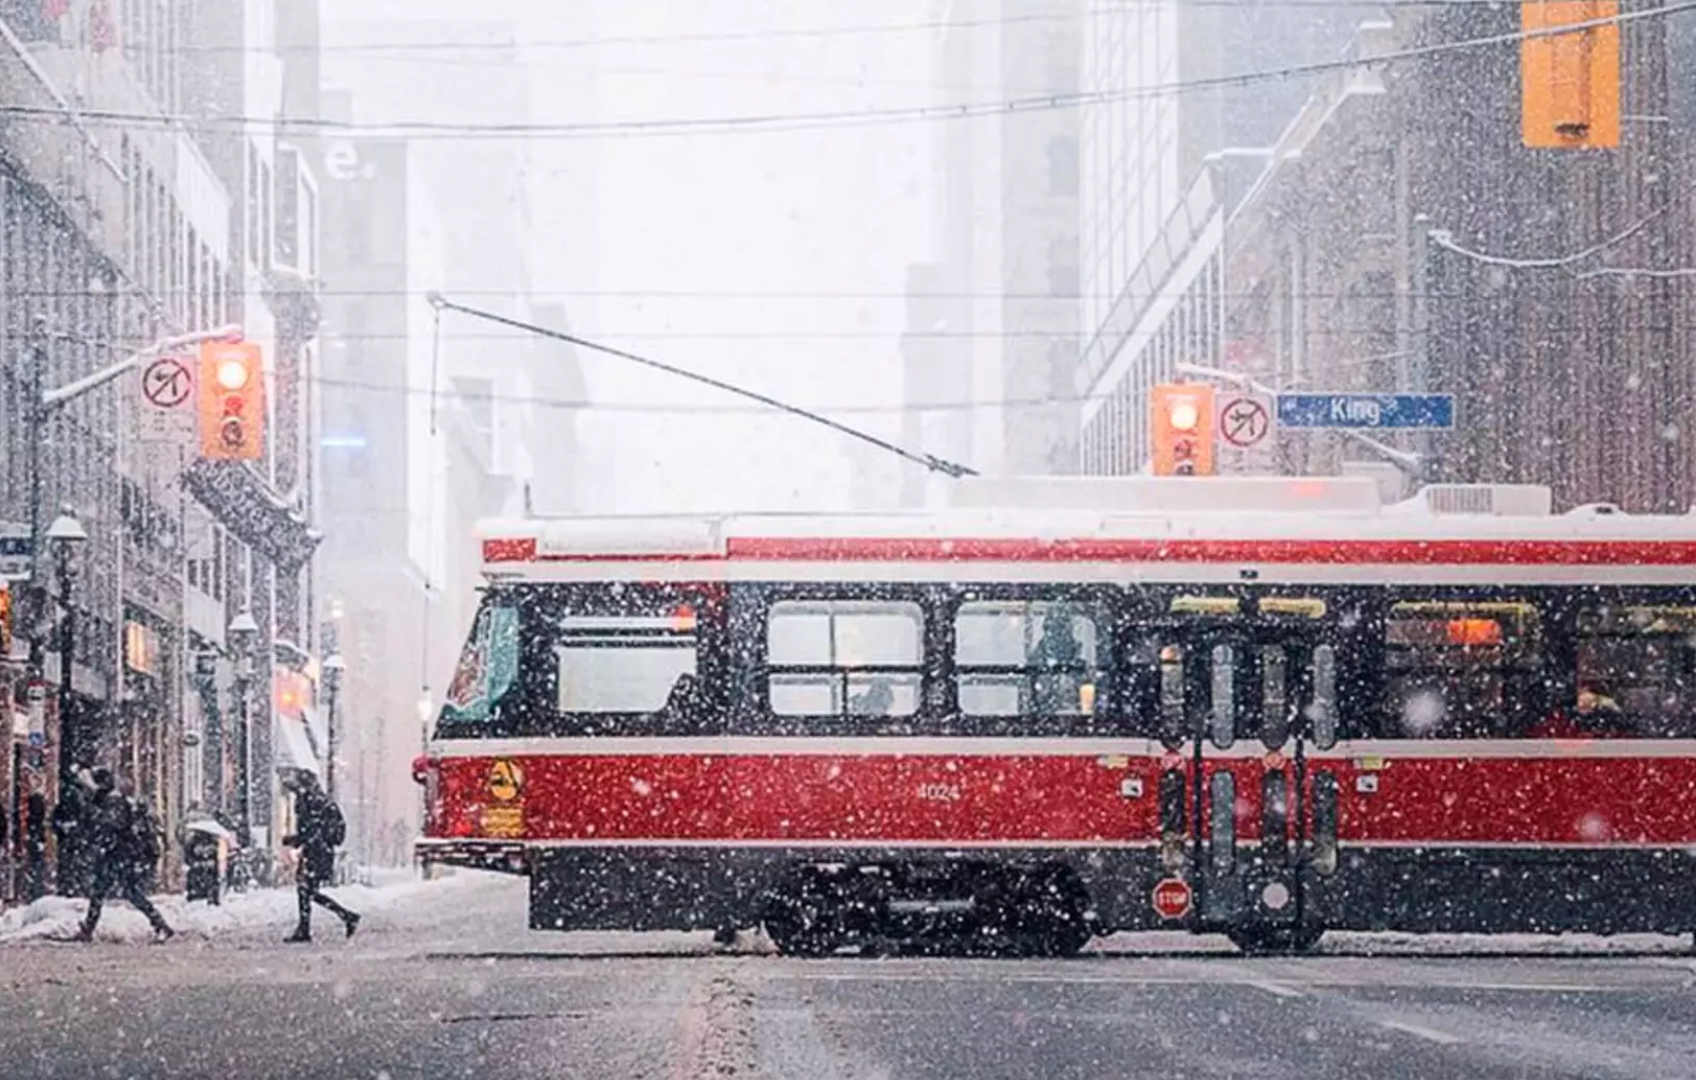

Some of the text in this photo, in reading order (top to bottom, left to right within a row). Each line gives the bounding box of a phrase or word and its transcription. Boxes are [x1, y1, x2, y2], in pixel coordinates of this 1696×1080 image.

[1331, 398, 1380, 425] King
[916, 783, 960, 800] 4024
[1159, 891, 1187, 905] STOP
